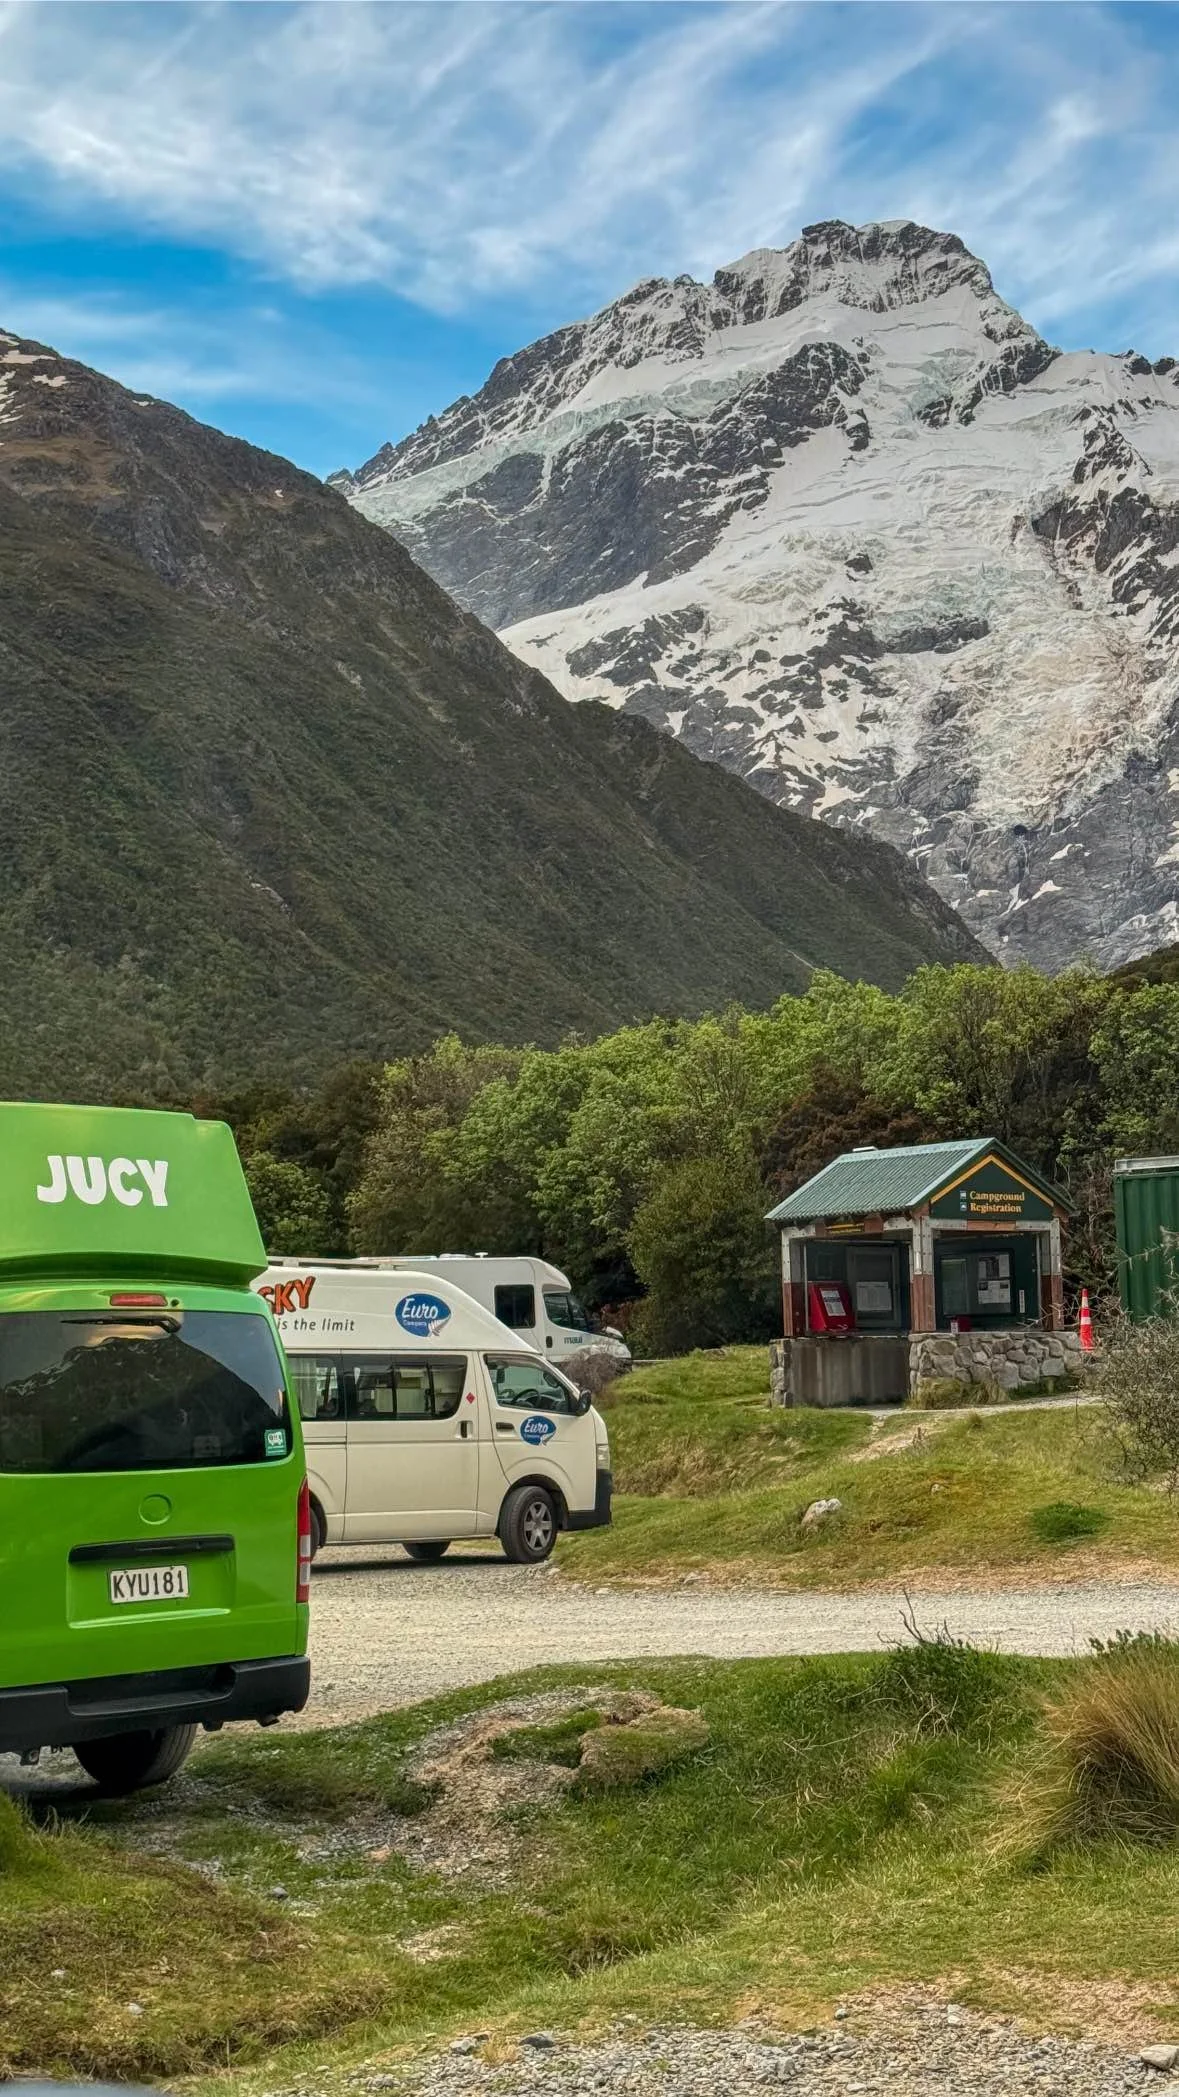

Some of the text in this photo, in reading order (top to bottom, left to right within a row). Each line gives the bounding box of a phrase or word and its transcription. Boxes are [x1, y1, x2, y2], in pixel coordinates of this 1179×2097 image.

[37, 1155, 168, 1206] JUCY
[969, 1191, 1025, 1202] Campground
[970, 1202, 1021, 1213] Registration
[402, 1298, 438, 1319] Euro
[277, 1317, 355, 1331] is the limit
[524, 1418, 549, 1434] Euro
[113, 1570, 183, 1598] KYU181
